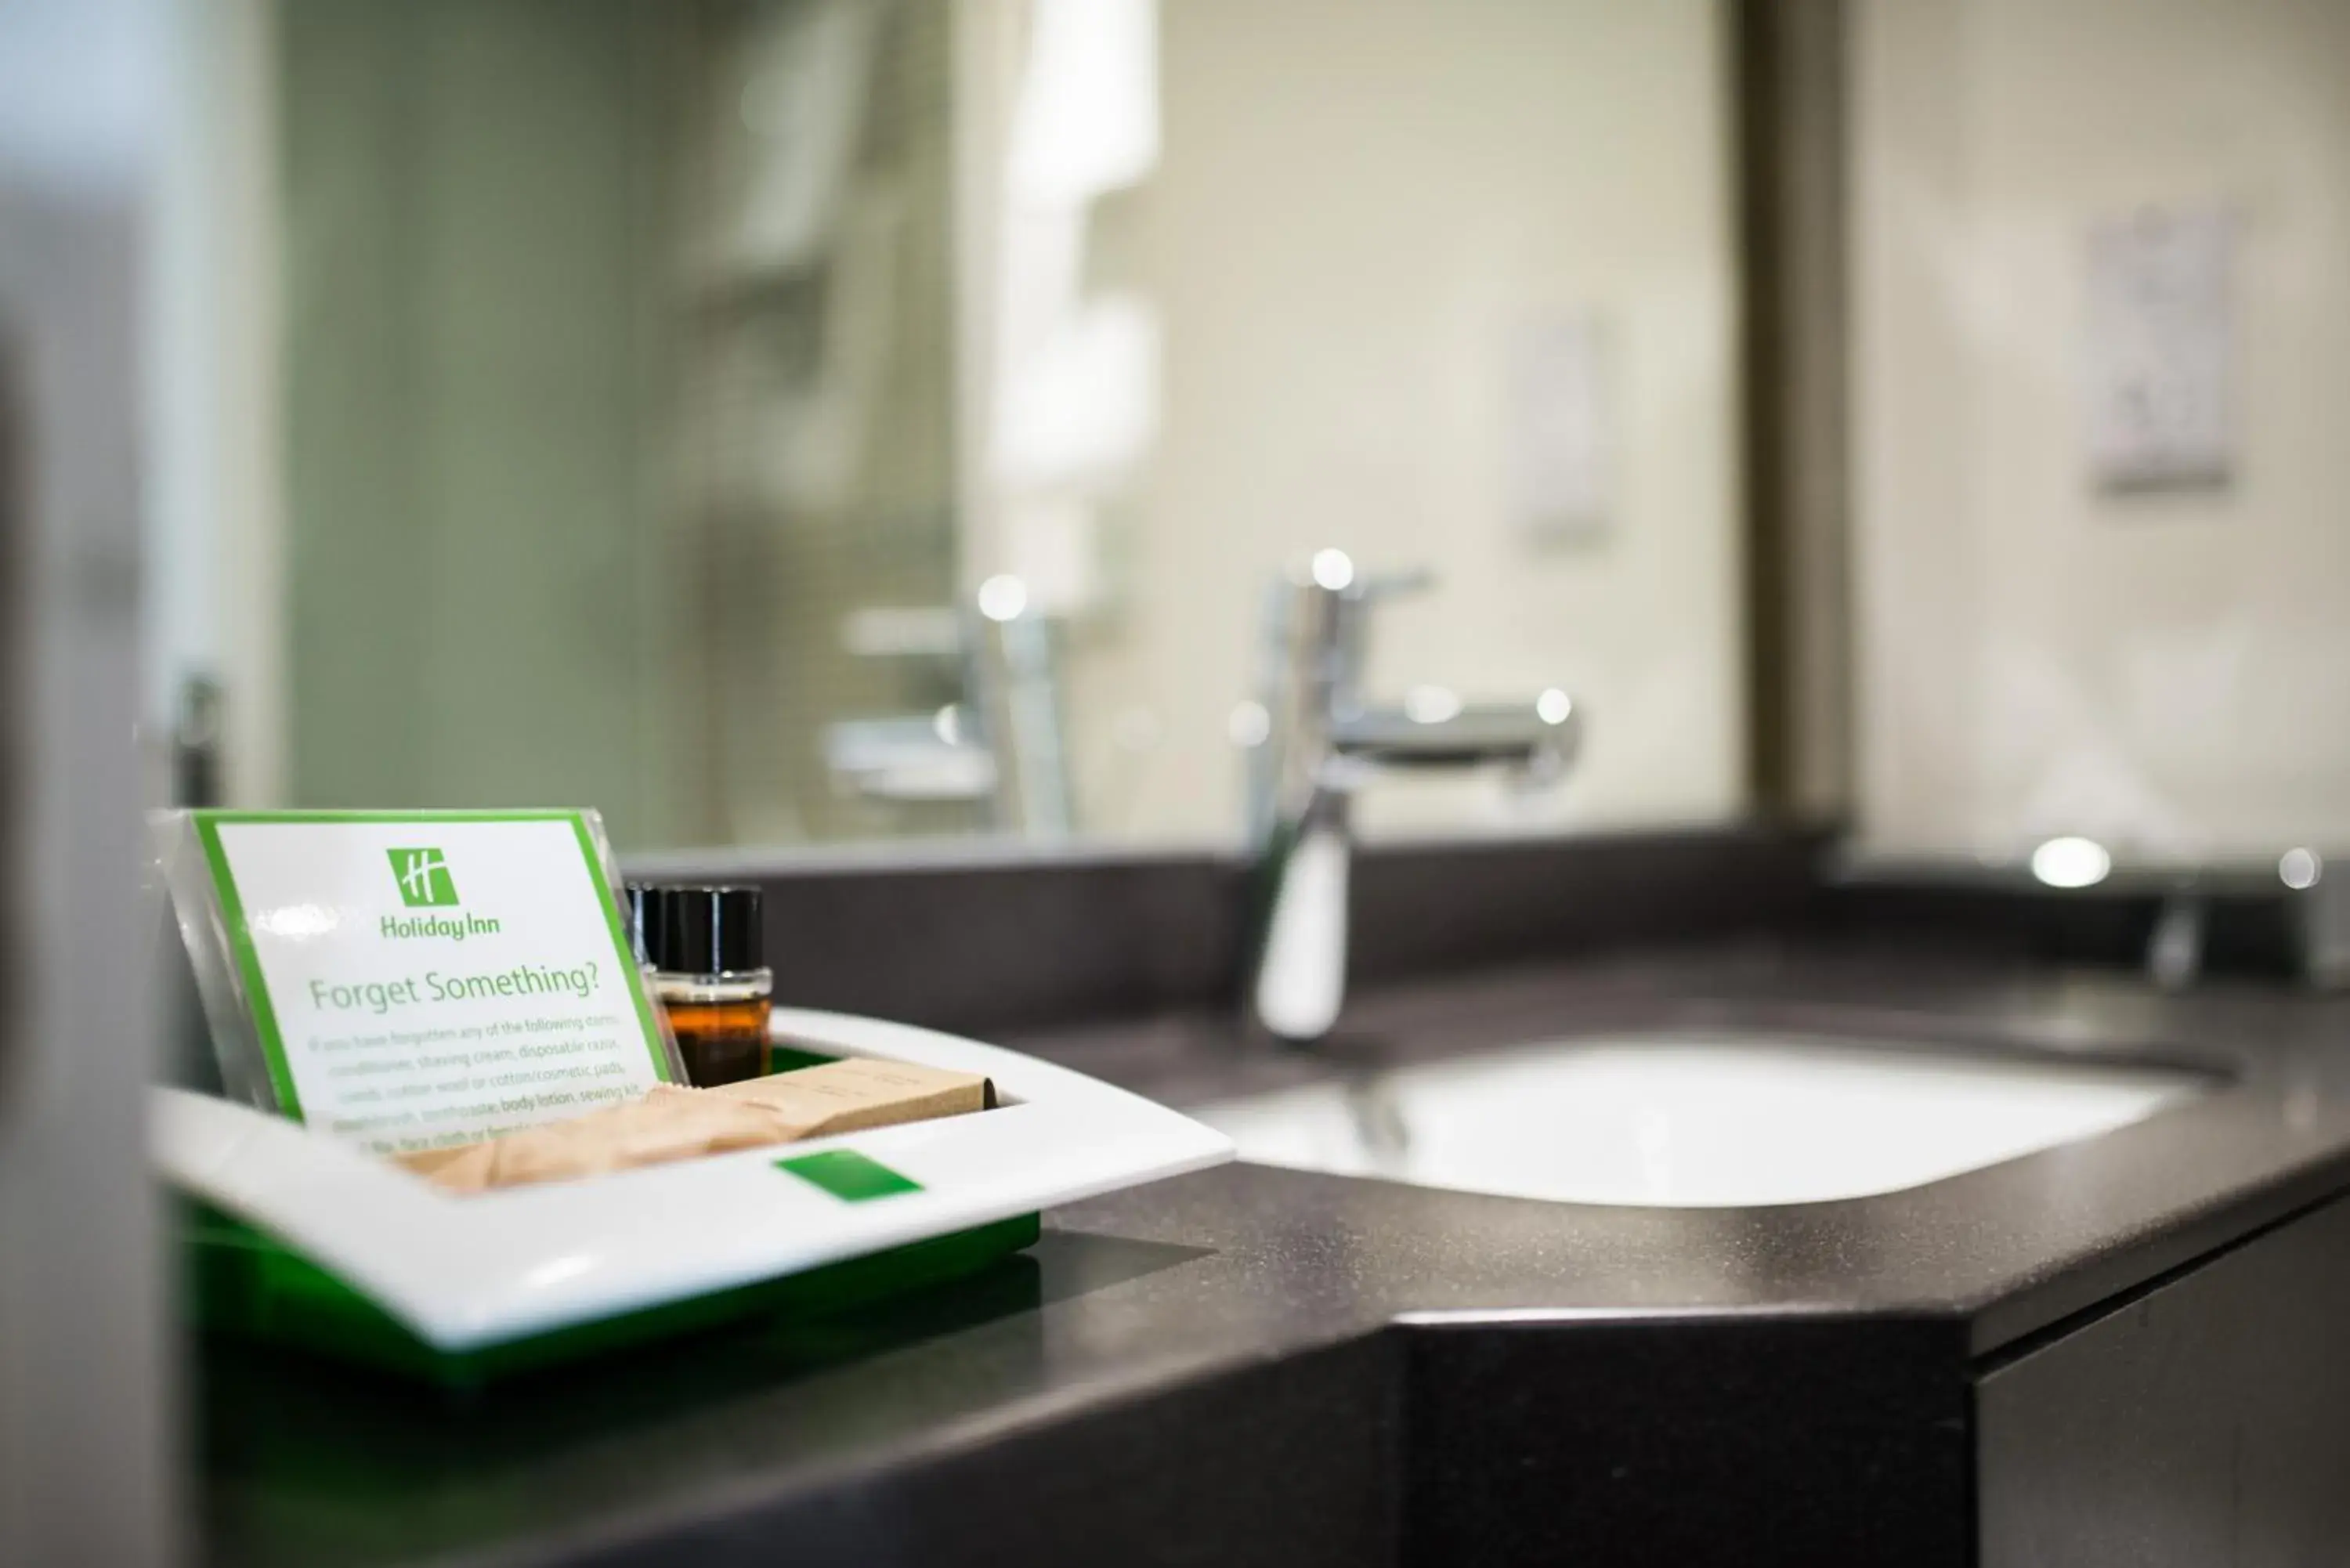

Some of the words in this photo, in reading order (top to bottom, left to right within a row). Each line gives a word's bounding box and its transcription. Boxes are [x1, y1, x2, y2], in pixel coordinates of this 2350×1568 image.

[380, 916, 465, 941] Holiday
[467, 912, 500, 934] Inn
[309, 979, 421, 1014] Forget
[425, 962, 599, 1003] Something?
